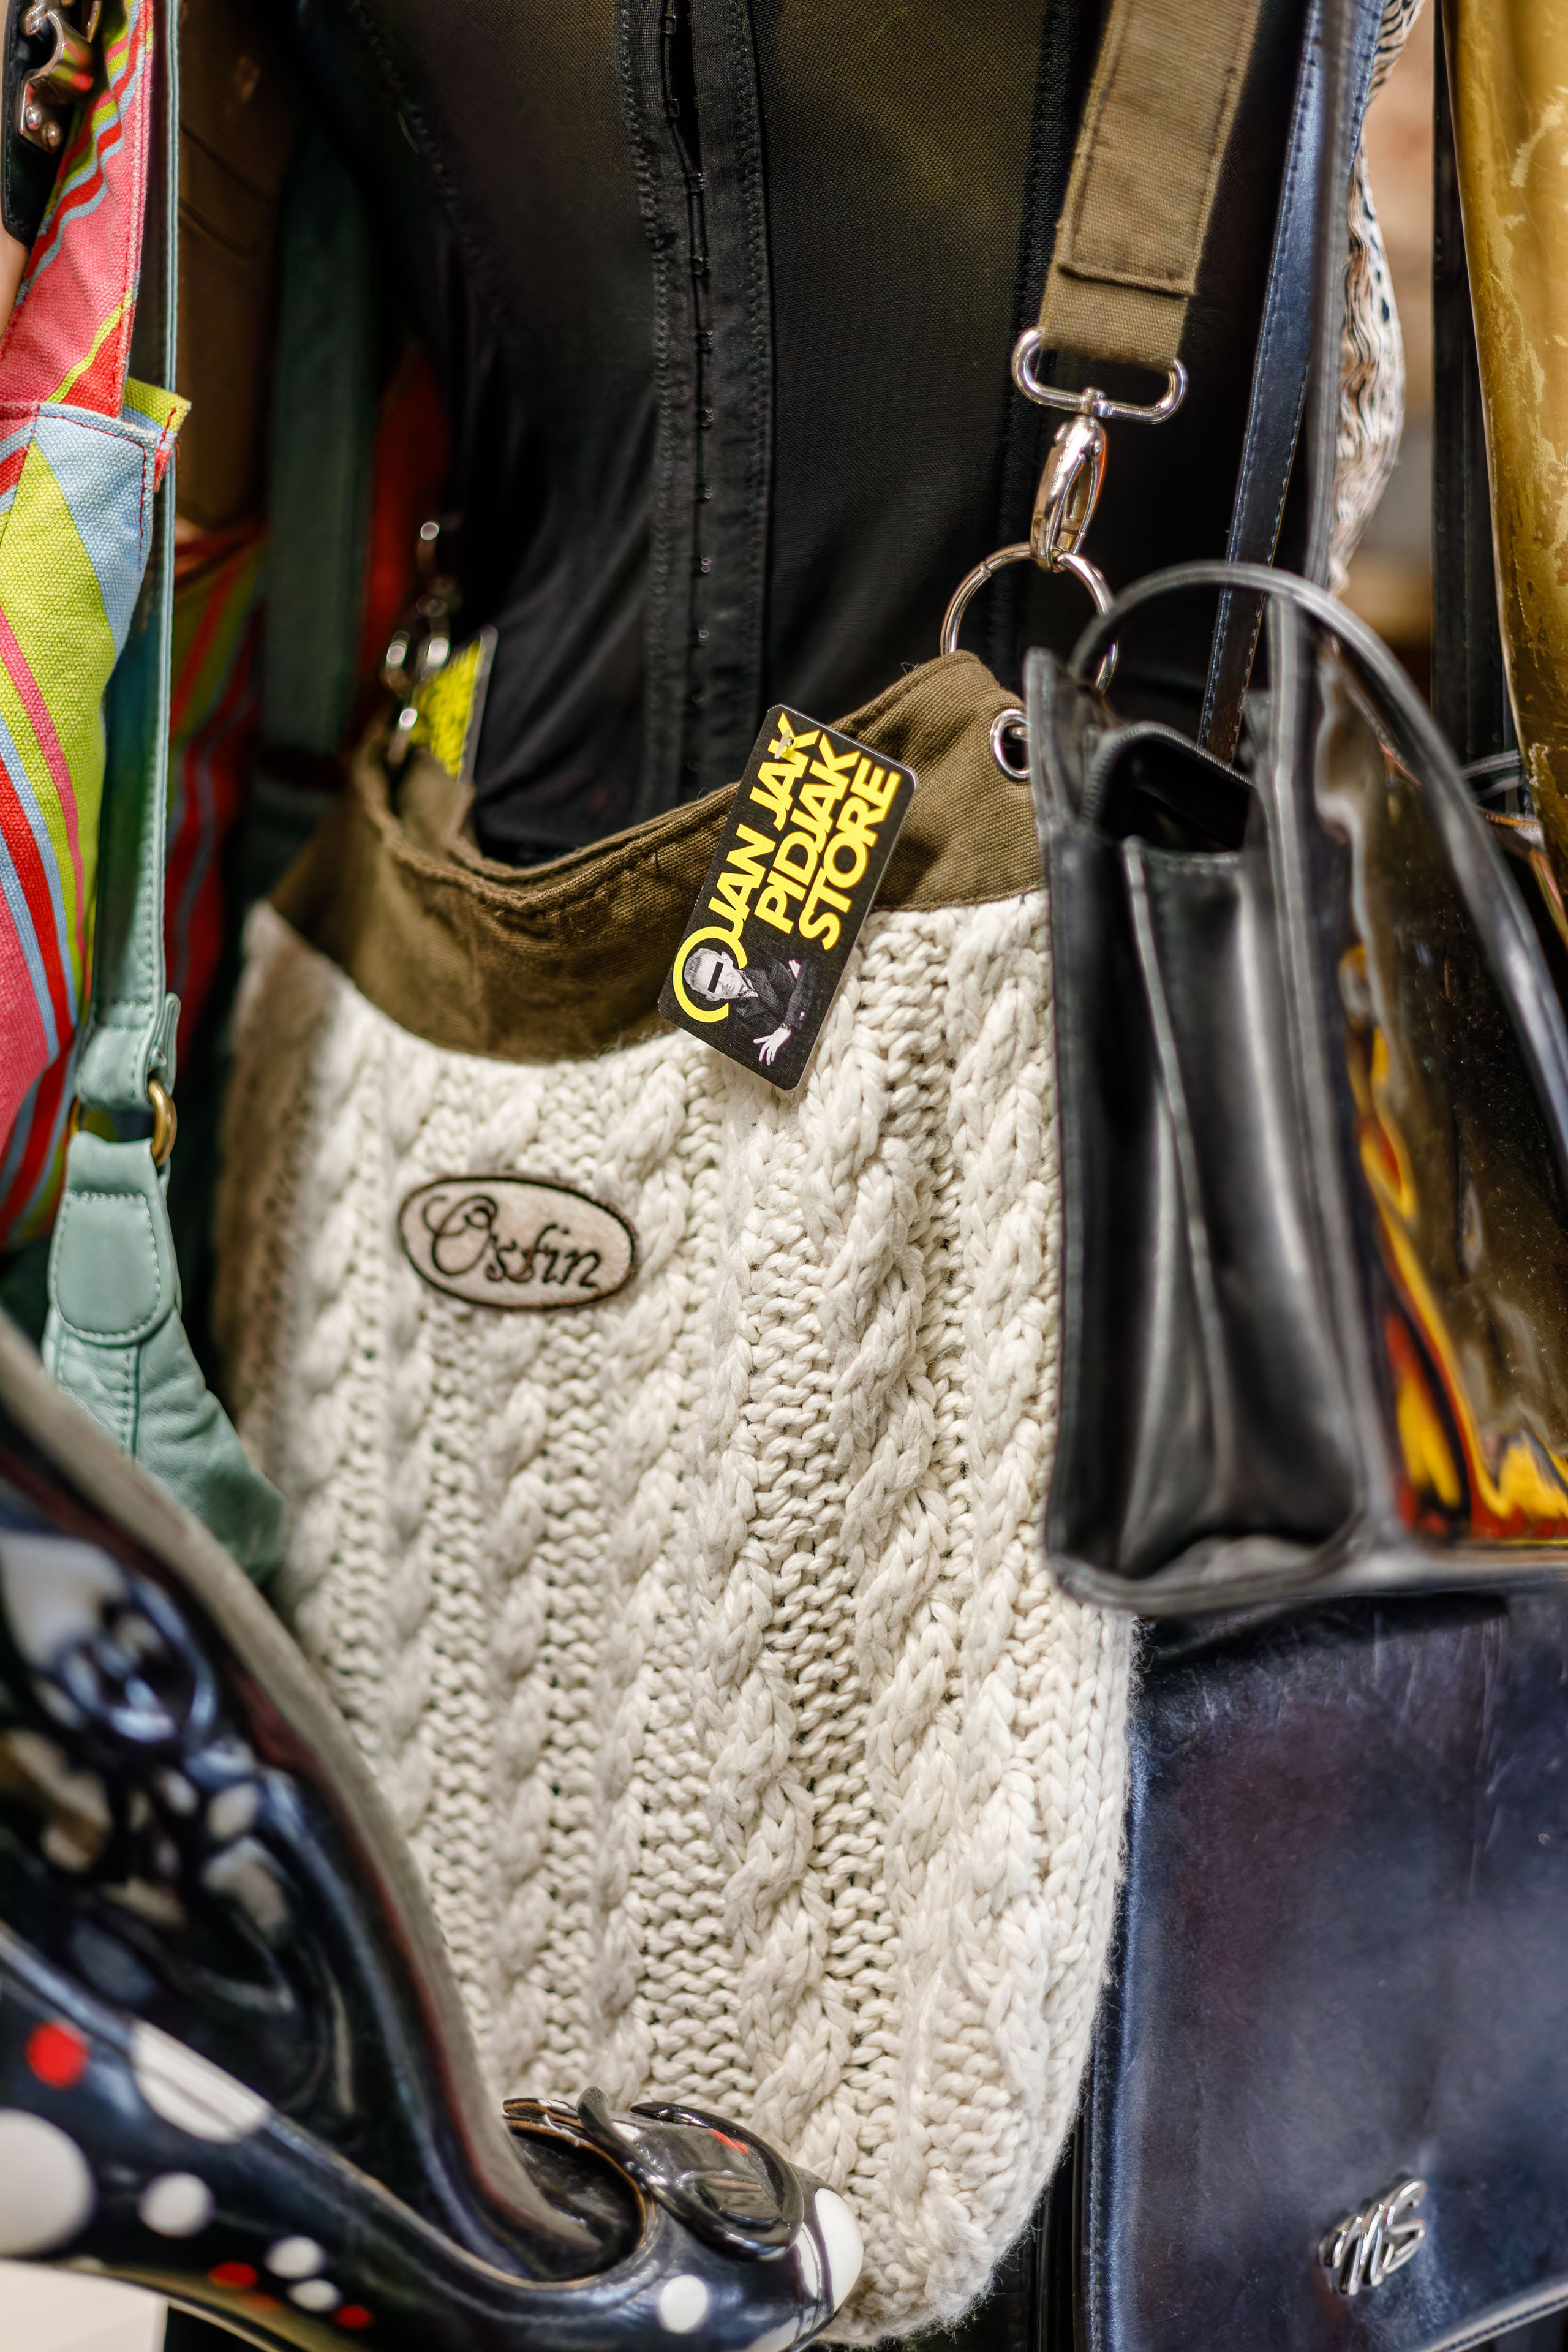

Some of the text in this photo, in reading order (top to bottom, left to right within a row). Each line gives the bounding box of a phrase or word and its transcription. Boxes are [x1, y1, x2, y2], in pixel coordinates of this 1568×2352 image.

[749, 712, 821, 831] JAK
[752, 733, 861, 935] PIDJAK
[797, 756, 903, 952] STORE
